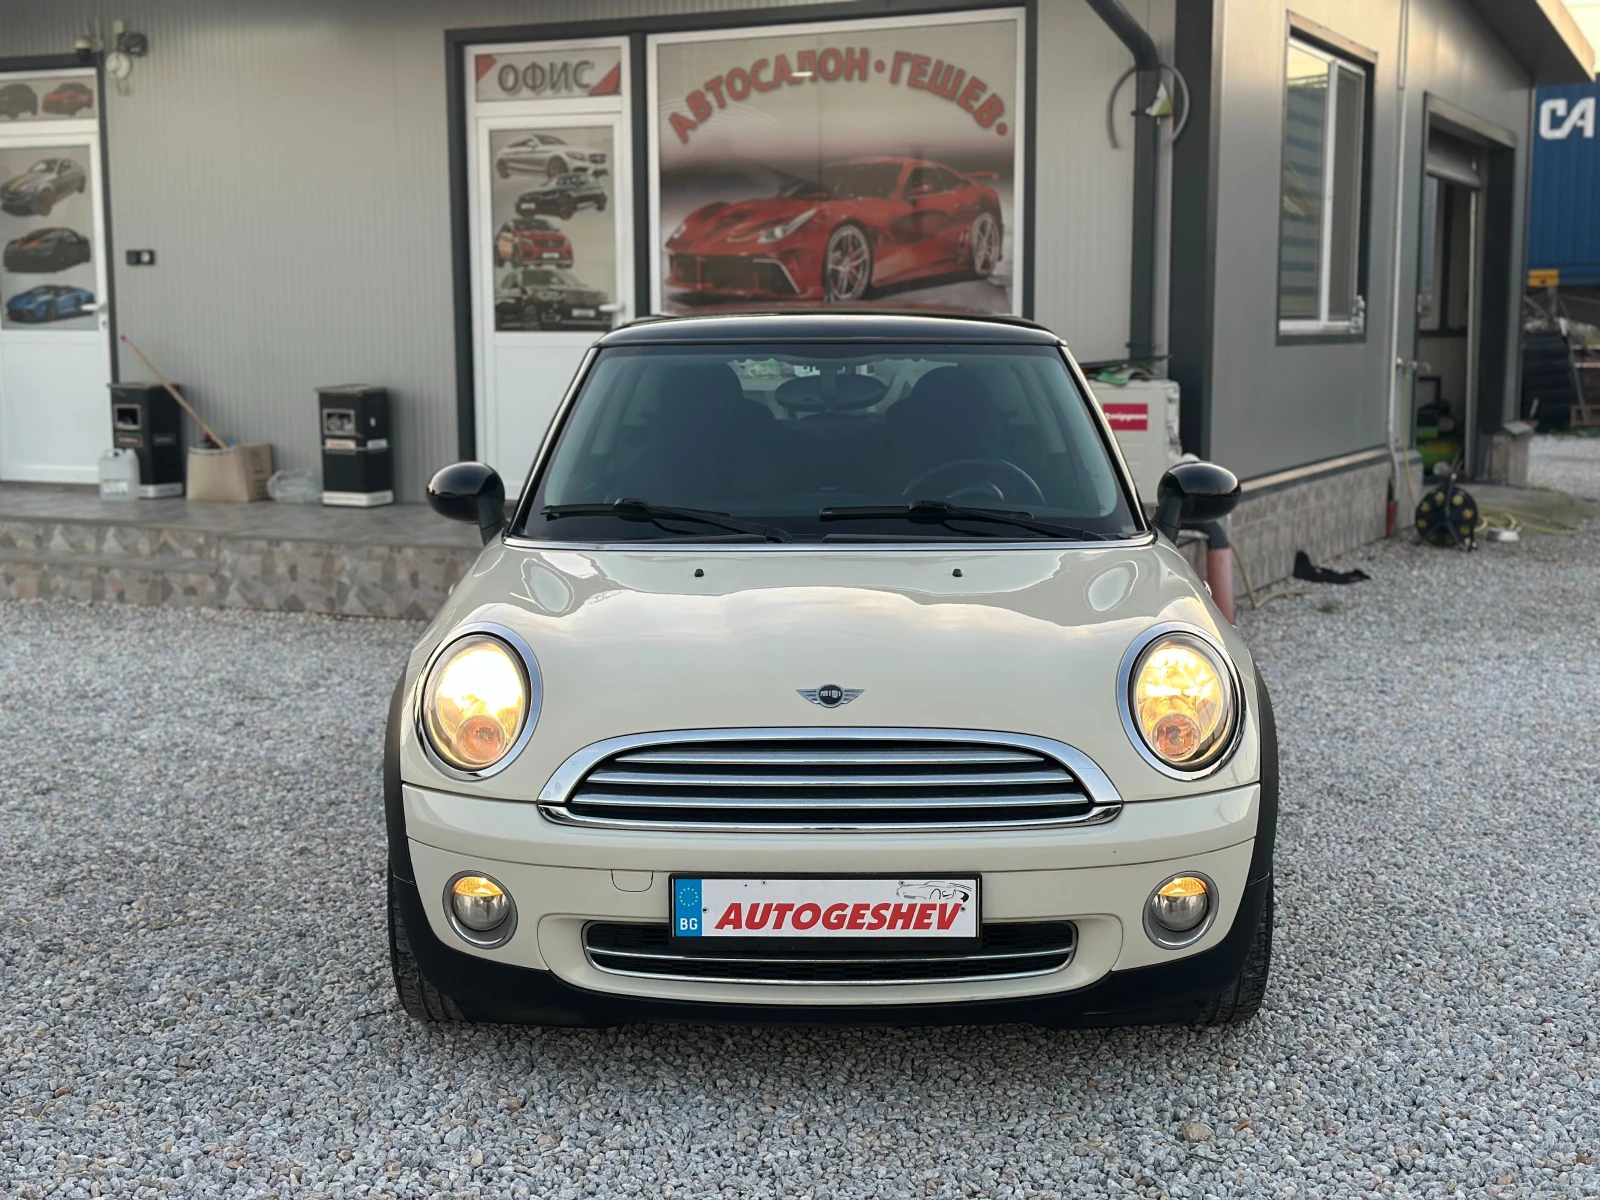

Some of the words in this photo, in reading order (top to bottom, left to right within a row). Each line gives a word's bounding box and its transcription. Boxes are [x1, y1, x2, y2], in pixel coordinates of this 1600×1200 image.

[497, 60, 594, 95] ОФИС
[668, 47, 870, 144] АВТОСАЛОН
[679, 917, 699, 931] BG
[713, 902, 963, 931] AUTOGESHEV
